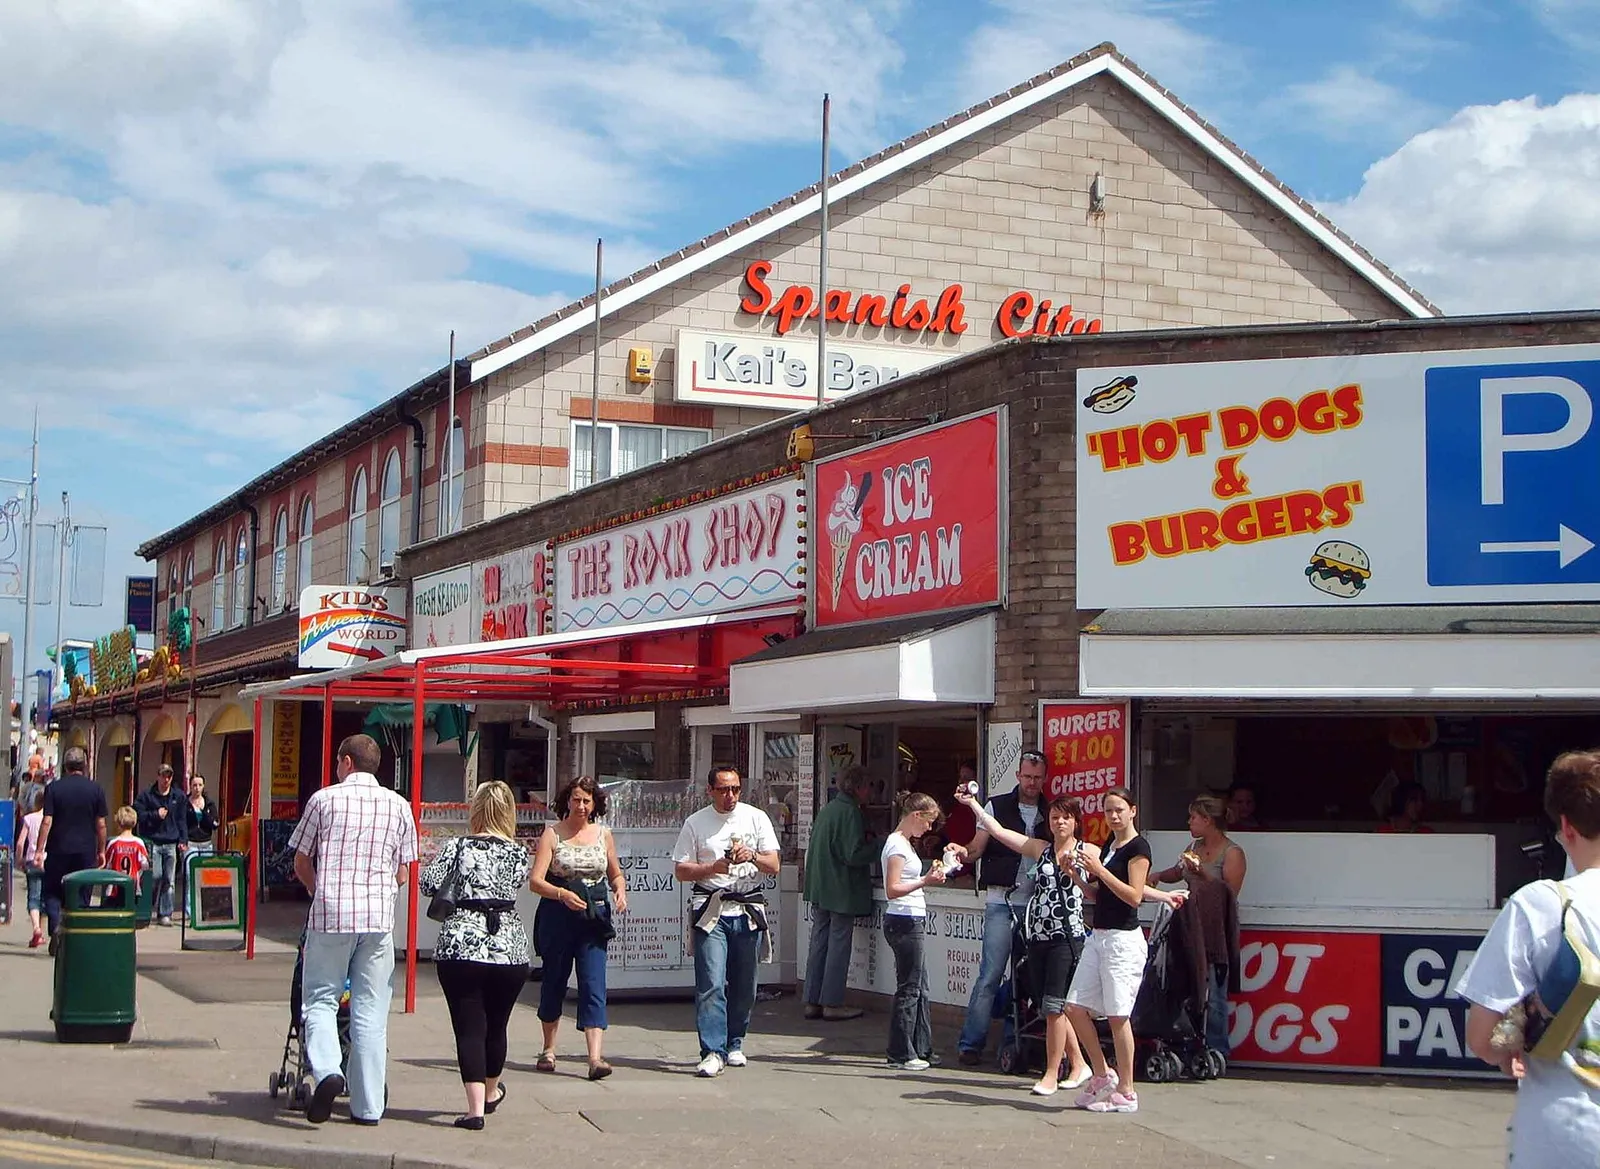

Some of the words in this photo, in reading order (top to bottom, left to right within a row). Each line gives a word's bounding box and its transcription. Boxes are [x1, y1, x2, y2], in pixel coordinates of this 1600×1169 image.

[741, 260, 968, 336] Spanish
[704, 340, 807, 387] Kai's
[1086, 414, 1212, 472] 'HOT
[1218, 383, 1364, 450] DOGS
[1480, 376, 1593, 505] P
[882, 456, 933, 526] ICE
[1211, 452, 1253, 500] &
[1107, 480, 1365, 566] BURGERS'
[568, 539, 611, 600] THE
[624, 517, 692, 589] ROCK
[702, 493, 785, 572] SHOP
[855, 523, 962, 600] CREAM
[319, 592, 389, 611] KIDS
[415, 586, 437, 616] FRESH
[437, 582, 469, 617] SEAFOOD
[304, 614, 401, 647] Adventure
[337, 629, 398, 640] WORLD
[279, 700, 296, 772] DVENTURE
[1047, 709, 1121, 737] BURGER
[990, 737, 1023, 789] CREAM
[992, 731, 1009, 764] ICE
[1054, 734, 1116, 766] £1.00
[1051, 767, 1118, 795] CHEESE
[121, 856, 131, 874] 9
[618, 856, 649, 869] CE
[621, 874, 674, 891] EAM
[947, 949, 981, 965] REGULAR
[947, 965, 970, 979] LARGE
[1240, 941, 1326, 993] OT
[1404, 948, 1478, 999] CA
[947, 981, 967, 994] CANS
[1227, 1003, 1351, 1055] OGS
[1386, 1006, 1472, 1058] PA
